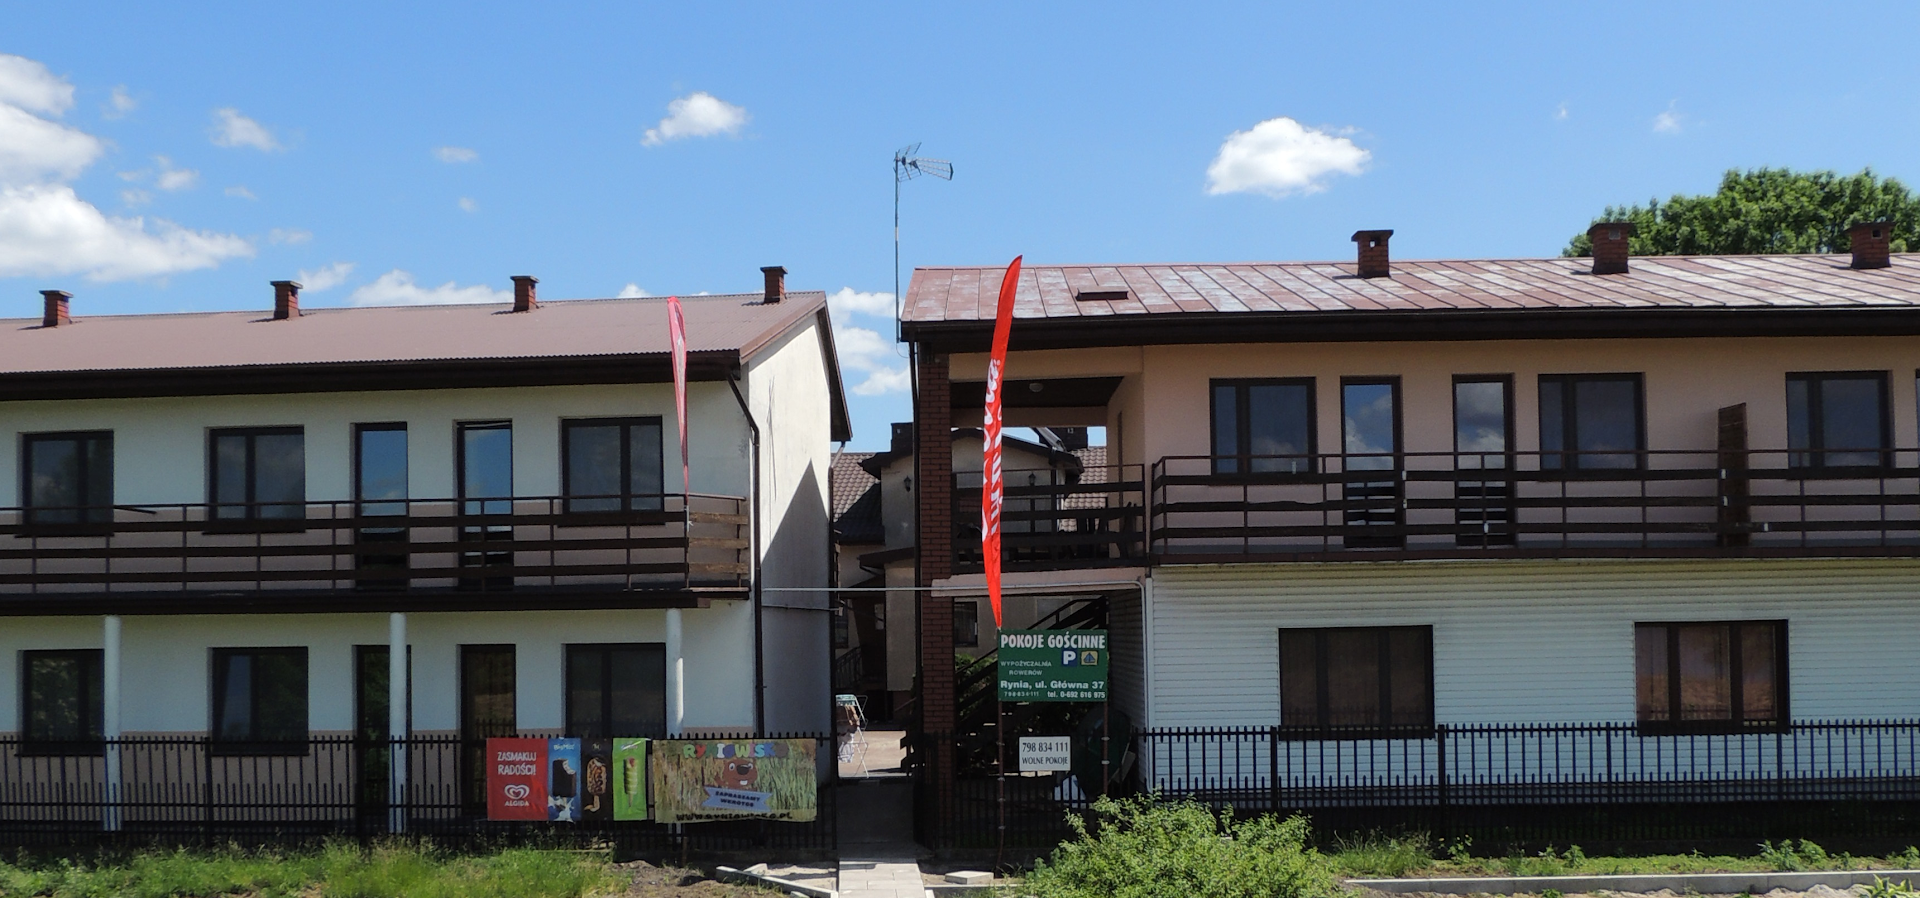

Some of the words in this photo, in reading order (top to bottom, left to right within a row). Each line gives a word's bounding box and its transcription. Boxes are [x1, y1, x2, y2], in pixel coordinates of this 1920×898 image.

[1001, 634, 1044, 649] POKOJE
[1048, 631, 1106, 649] GOŚCINNE
[1063, 650, 1076, 665] P
[1000, 680, 1032, 690] Rynia,
[1035, 680, 1047, 689] ul.
[1050, 680, 1089, 689] Główna
[1092, 681, 1105, 689] 37
[683, 743, 790, 759] RYNIOWISKO
[1022, 742, 1036, 752] 798
[1038, 742, 1053, 752] 834
[1055, 742, 1068, 752] 111
[497, 751, 537, 762] ZASMAKUJ
[1022, 756, 1044, 765] WOLNE
[1045, 756, 1068, 765] POKOJE
[498, 762, 537, 776] RADOŚCI!
